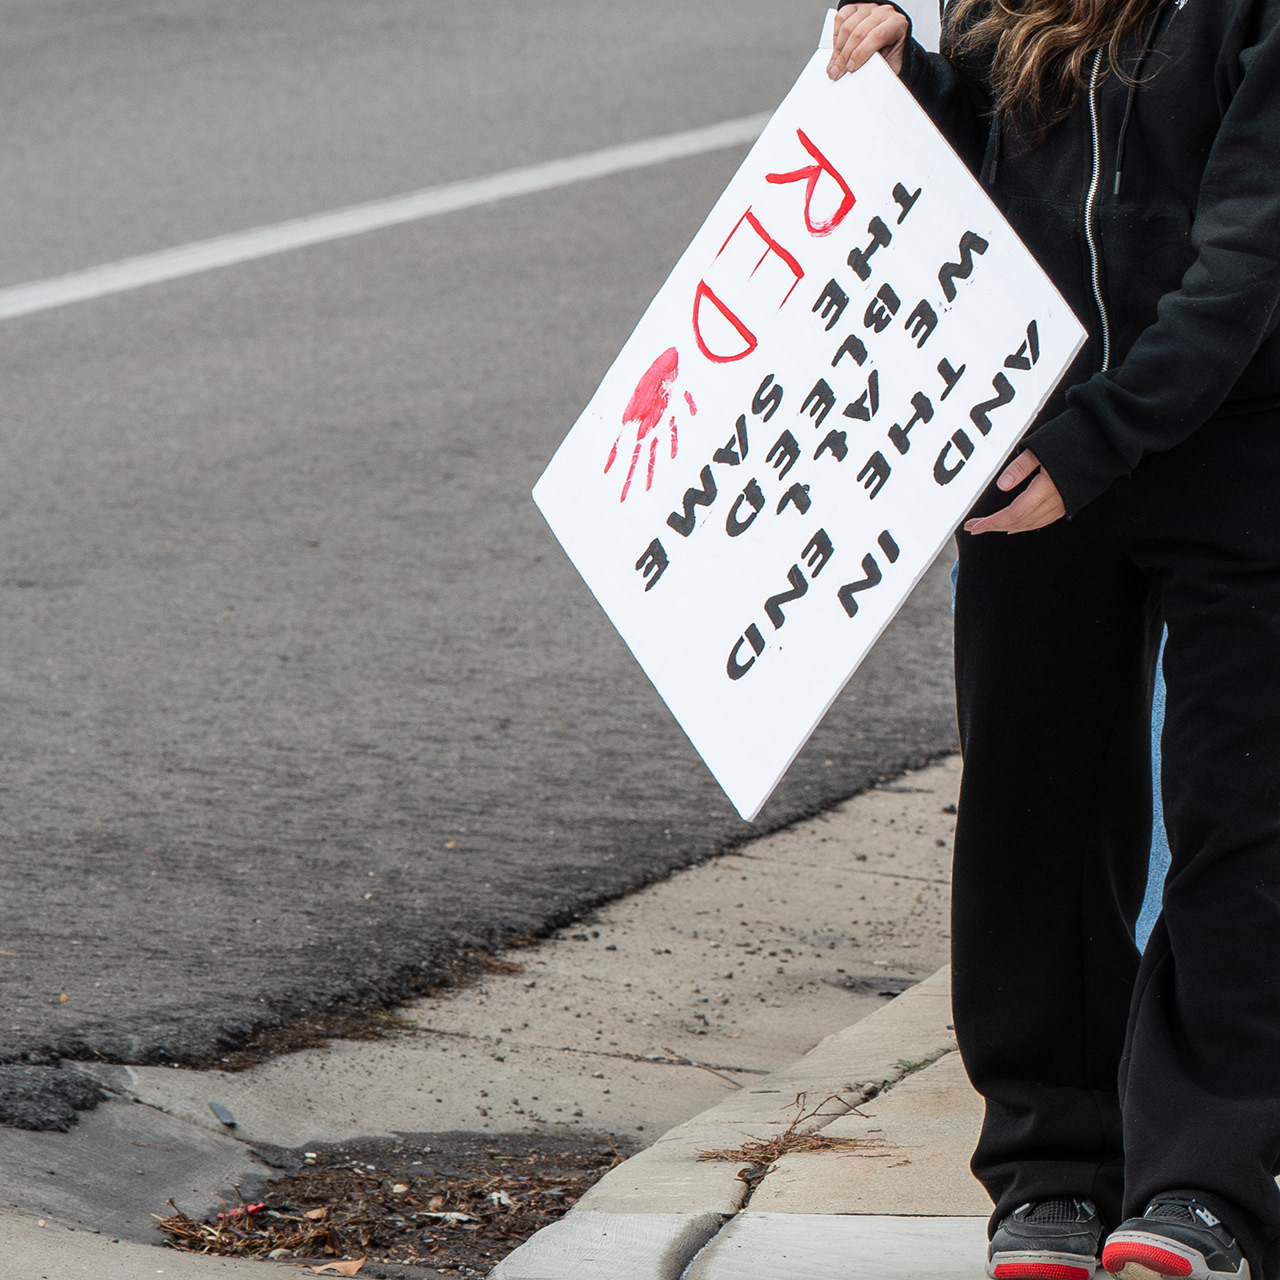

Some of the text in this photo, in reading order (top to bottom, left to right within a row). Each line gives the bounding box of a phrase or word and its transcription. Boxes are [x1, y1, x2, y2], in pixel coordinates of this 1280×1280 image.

[635, 181, 924, 594] THE SAME
[691, 127, 857, 365] RED
[776, 230, 990, 517] WE ALL
[725, 282, 902, 539] BLEED
[726, 357, 968, 681] THE END
[838, 319, 1042, 619] AND IN
